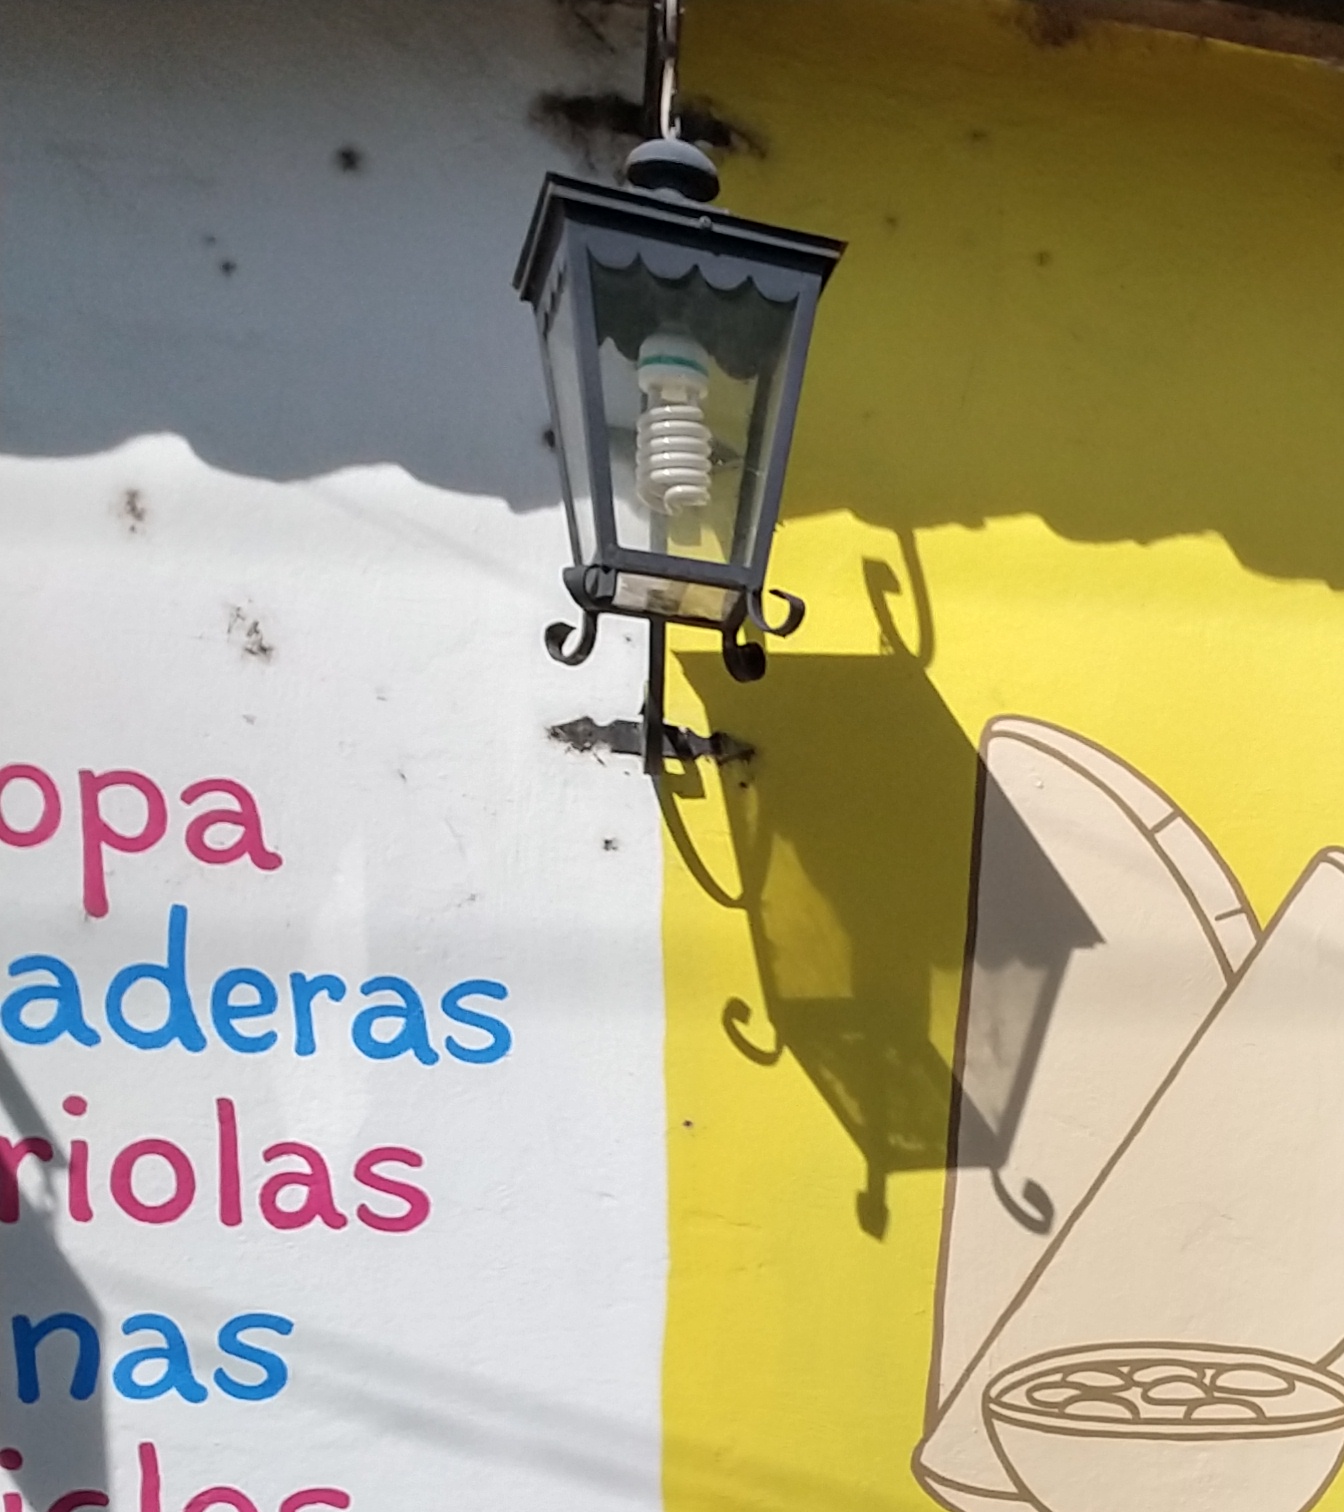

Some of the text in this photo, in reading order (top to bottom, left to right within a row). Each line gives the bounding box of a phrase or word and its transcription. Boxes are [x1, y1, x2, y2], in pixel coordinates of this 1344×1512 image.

[0, 763, 283, 919] opa
[0, 904, 512, 1067] aderas
[0, 1096, 431, 1233] riolas
[11, 1312, 294, 1404] nas
